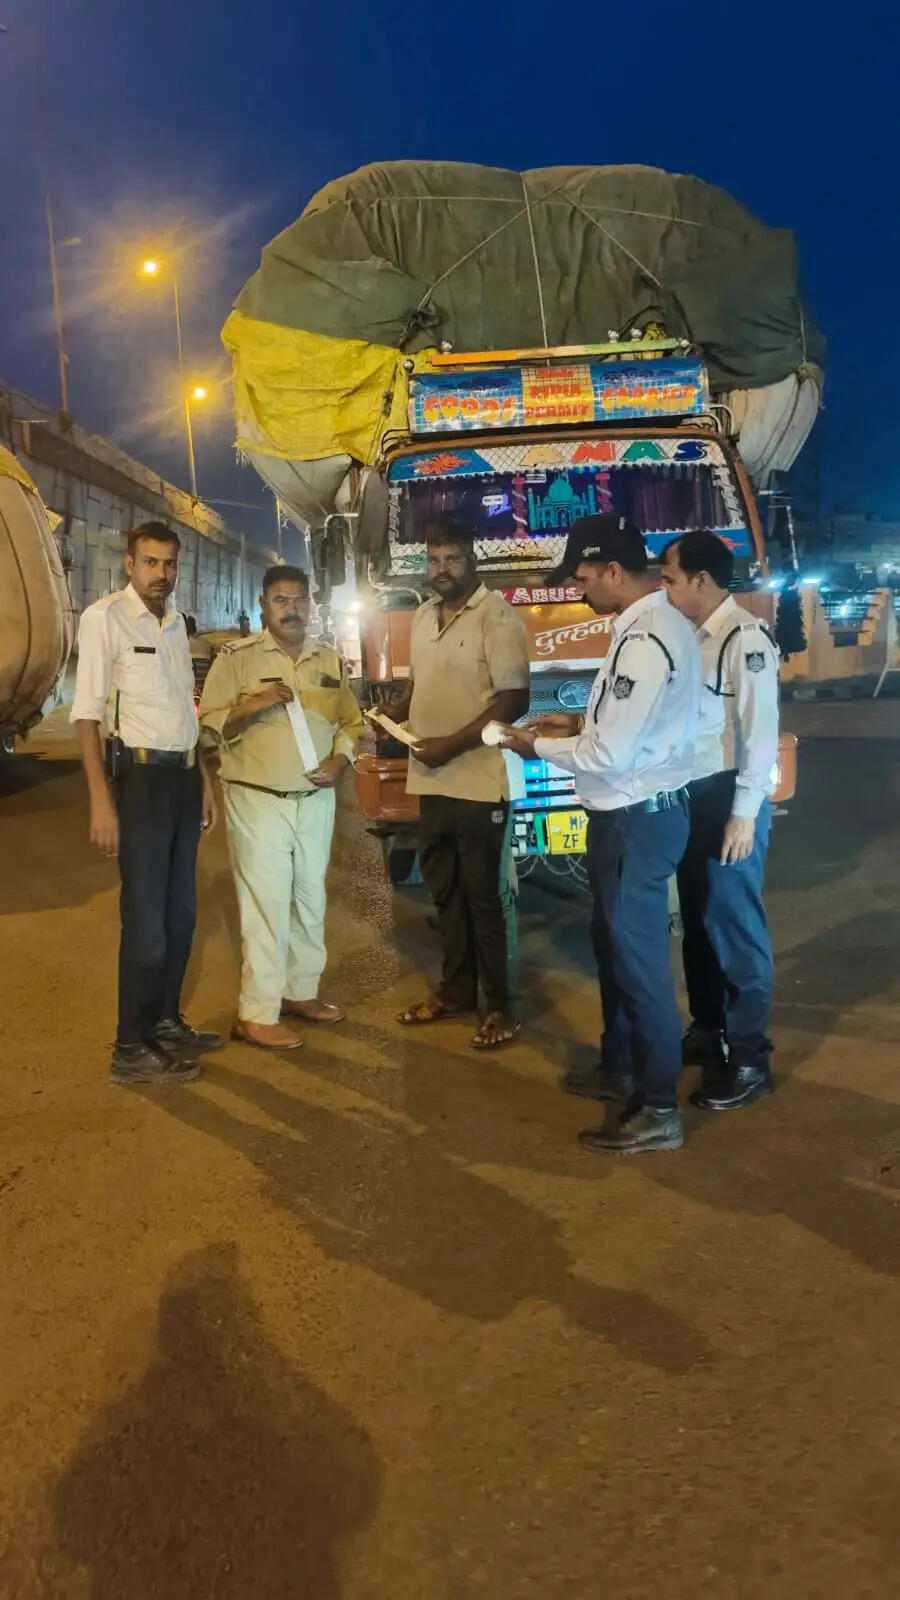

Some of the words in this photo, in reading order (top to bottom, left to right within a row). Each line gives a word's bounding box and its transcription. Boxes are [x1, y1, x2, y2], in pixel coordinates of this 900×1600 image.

[602, 384, 698, 412] CARRIER
[511, 587, 585, 604] ABUS
[534, 615, 614, 656] दुल्हन
[562, 833, 579, 849] ZF
